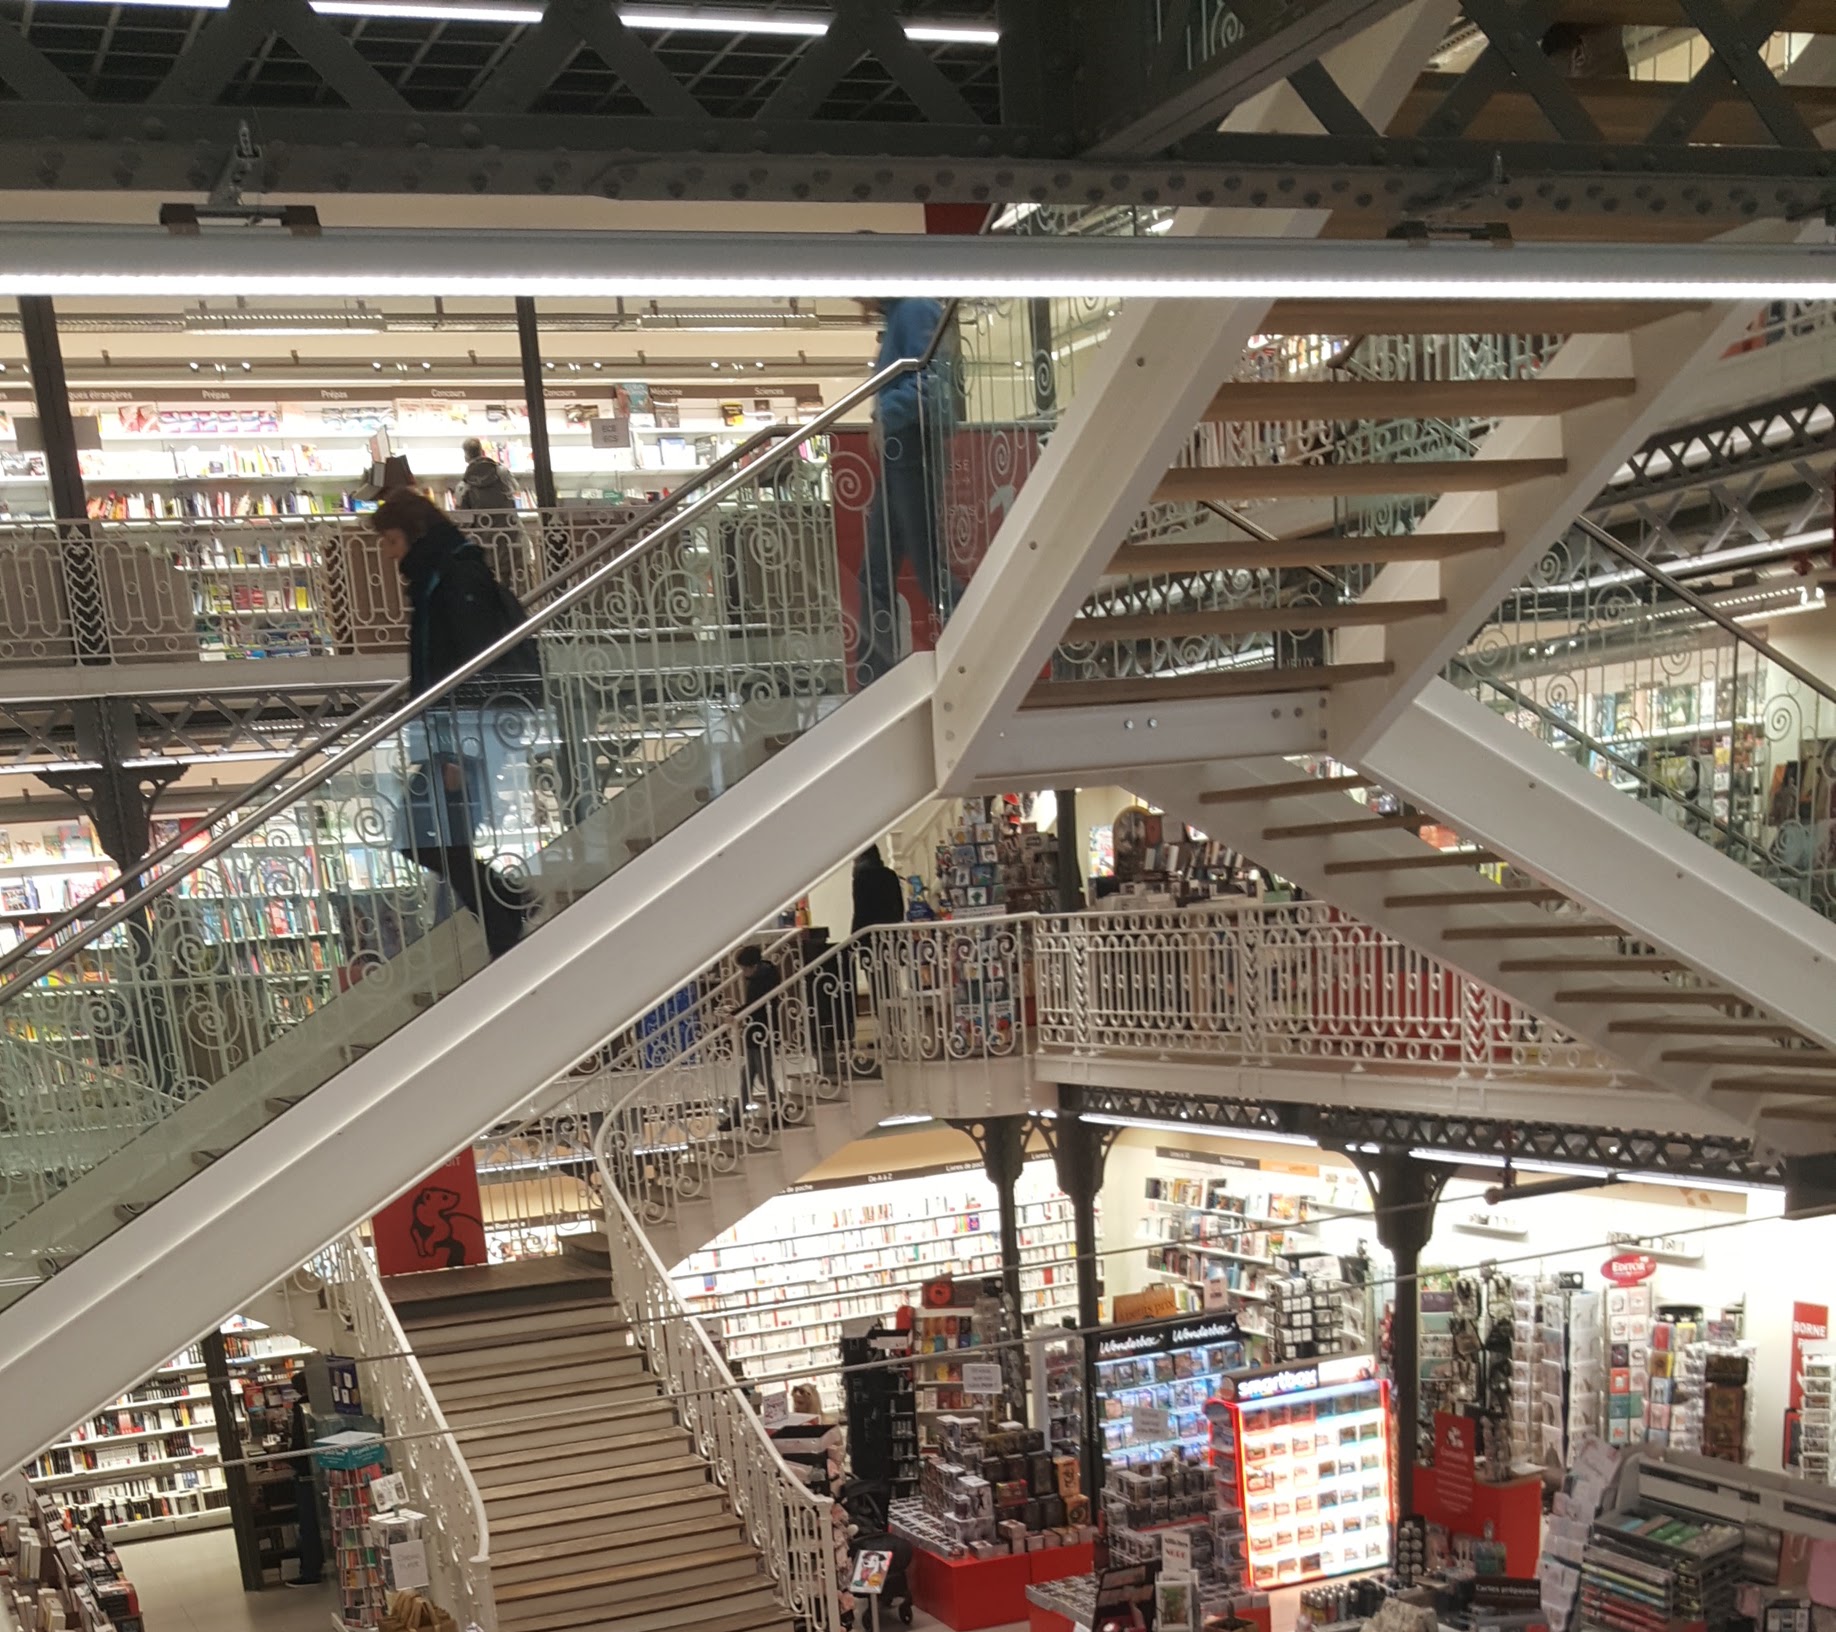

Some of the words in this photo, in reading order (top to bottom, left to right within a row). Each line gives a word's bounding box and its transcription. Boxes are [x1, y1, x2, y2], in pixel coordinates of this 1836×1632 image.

[431, 388, 467, 398] Concours
[1792, 1320, 1827, 1339] BORNE
[1237, 1369, 1318, 1395] smartbox
